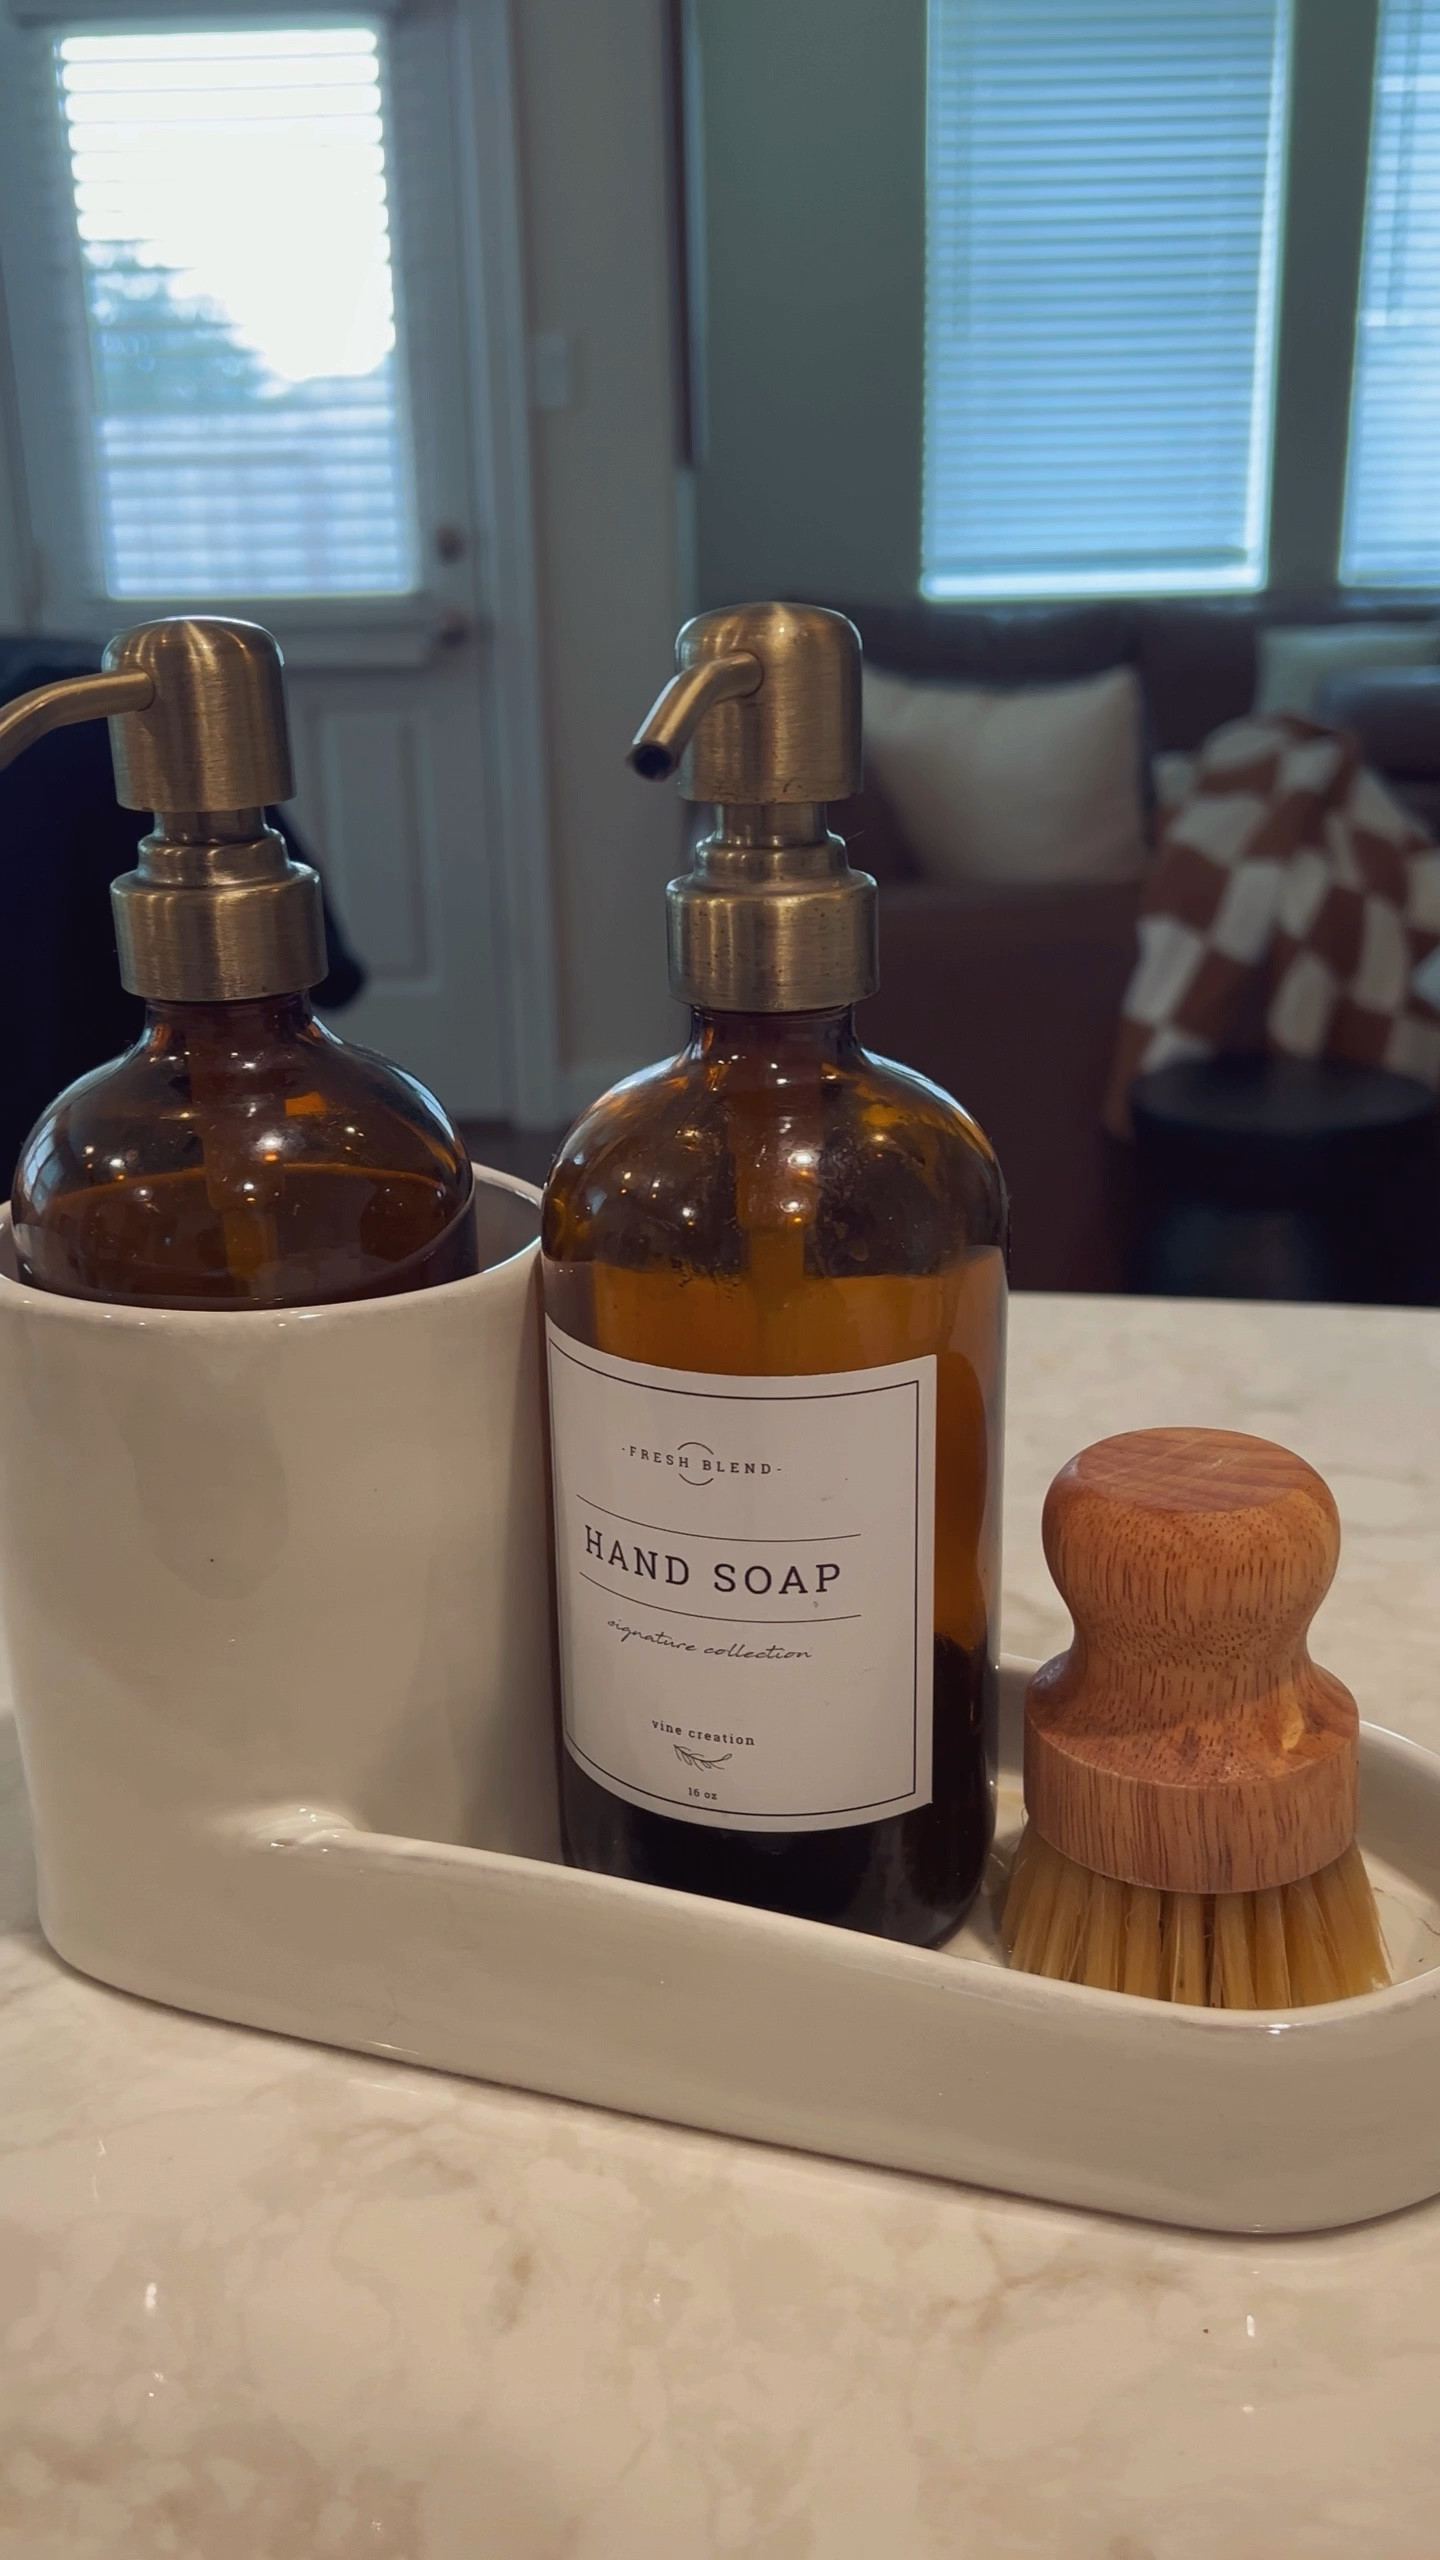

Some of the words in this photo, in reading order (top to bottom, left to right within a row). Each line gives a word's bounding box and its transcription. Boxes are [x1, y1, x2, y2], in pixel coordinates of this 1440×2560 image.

[584, 1524, 690, 1586] HAND
[713, 1563, 841, 1595] SOAP
[607, 1618, 697, 1652] signature
[703, 1643, 812, 1660] collection
[651, 1719, 682, 1736] vine
[688, 1728, 755, 1746] creation
[688, 1787, 700, 1798] 16
[704, 1791, 718, 1801] oz
